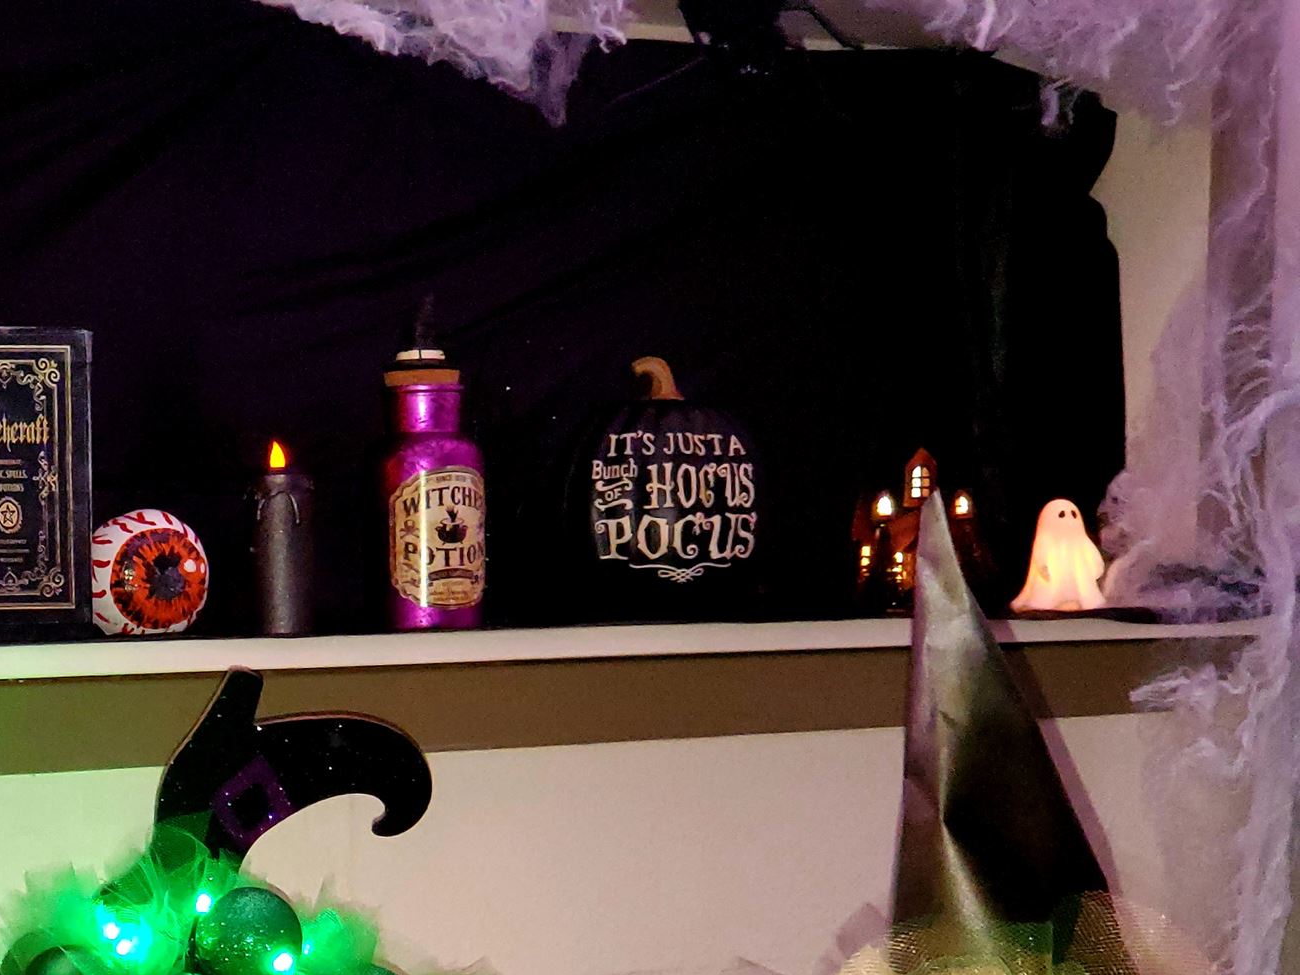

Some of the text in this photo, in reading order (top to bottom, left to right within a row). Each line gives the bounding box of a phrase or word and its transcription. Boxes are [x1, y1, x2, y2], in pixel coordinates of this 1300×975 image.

[607, 430, 746, 457] IT'S JUST A
[592, 458, 638, 479] Bunch
[643, 462, 755, 509] HOCUS
[595, 512, 757, 560] POCUS
